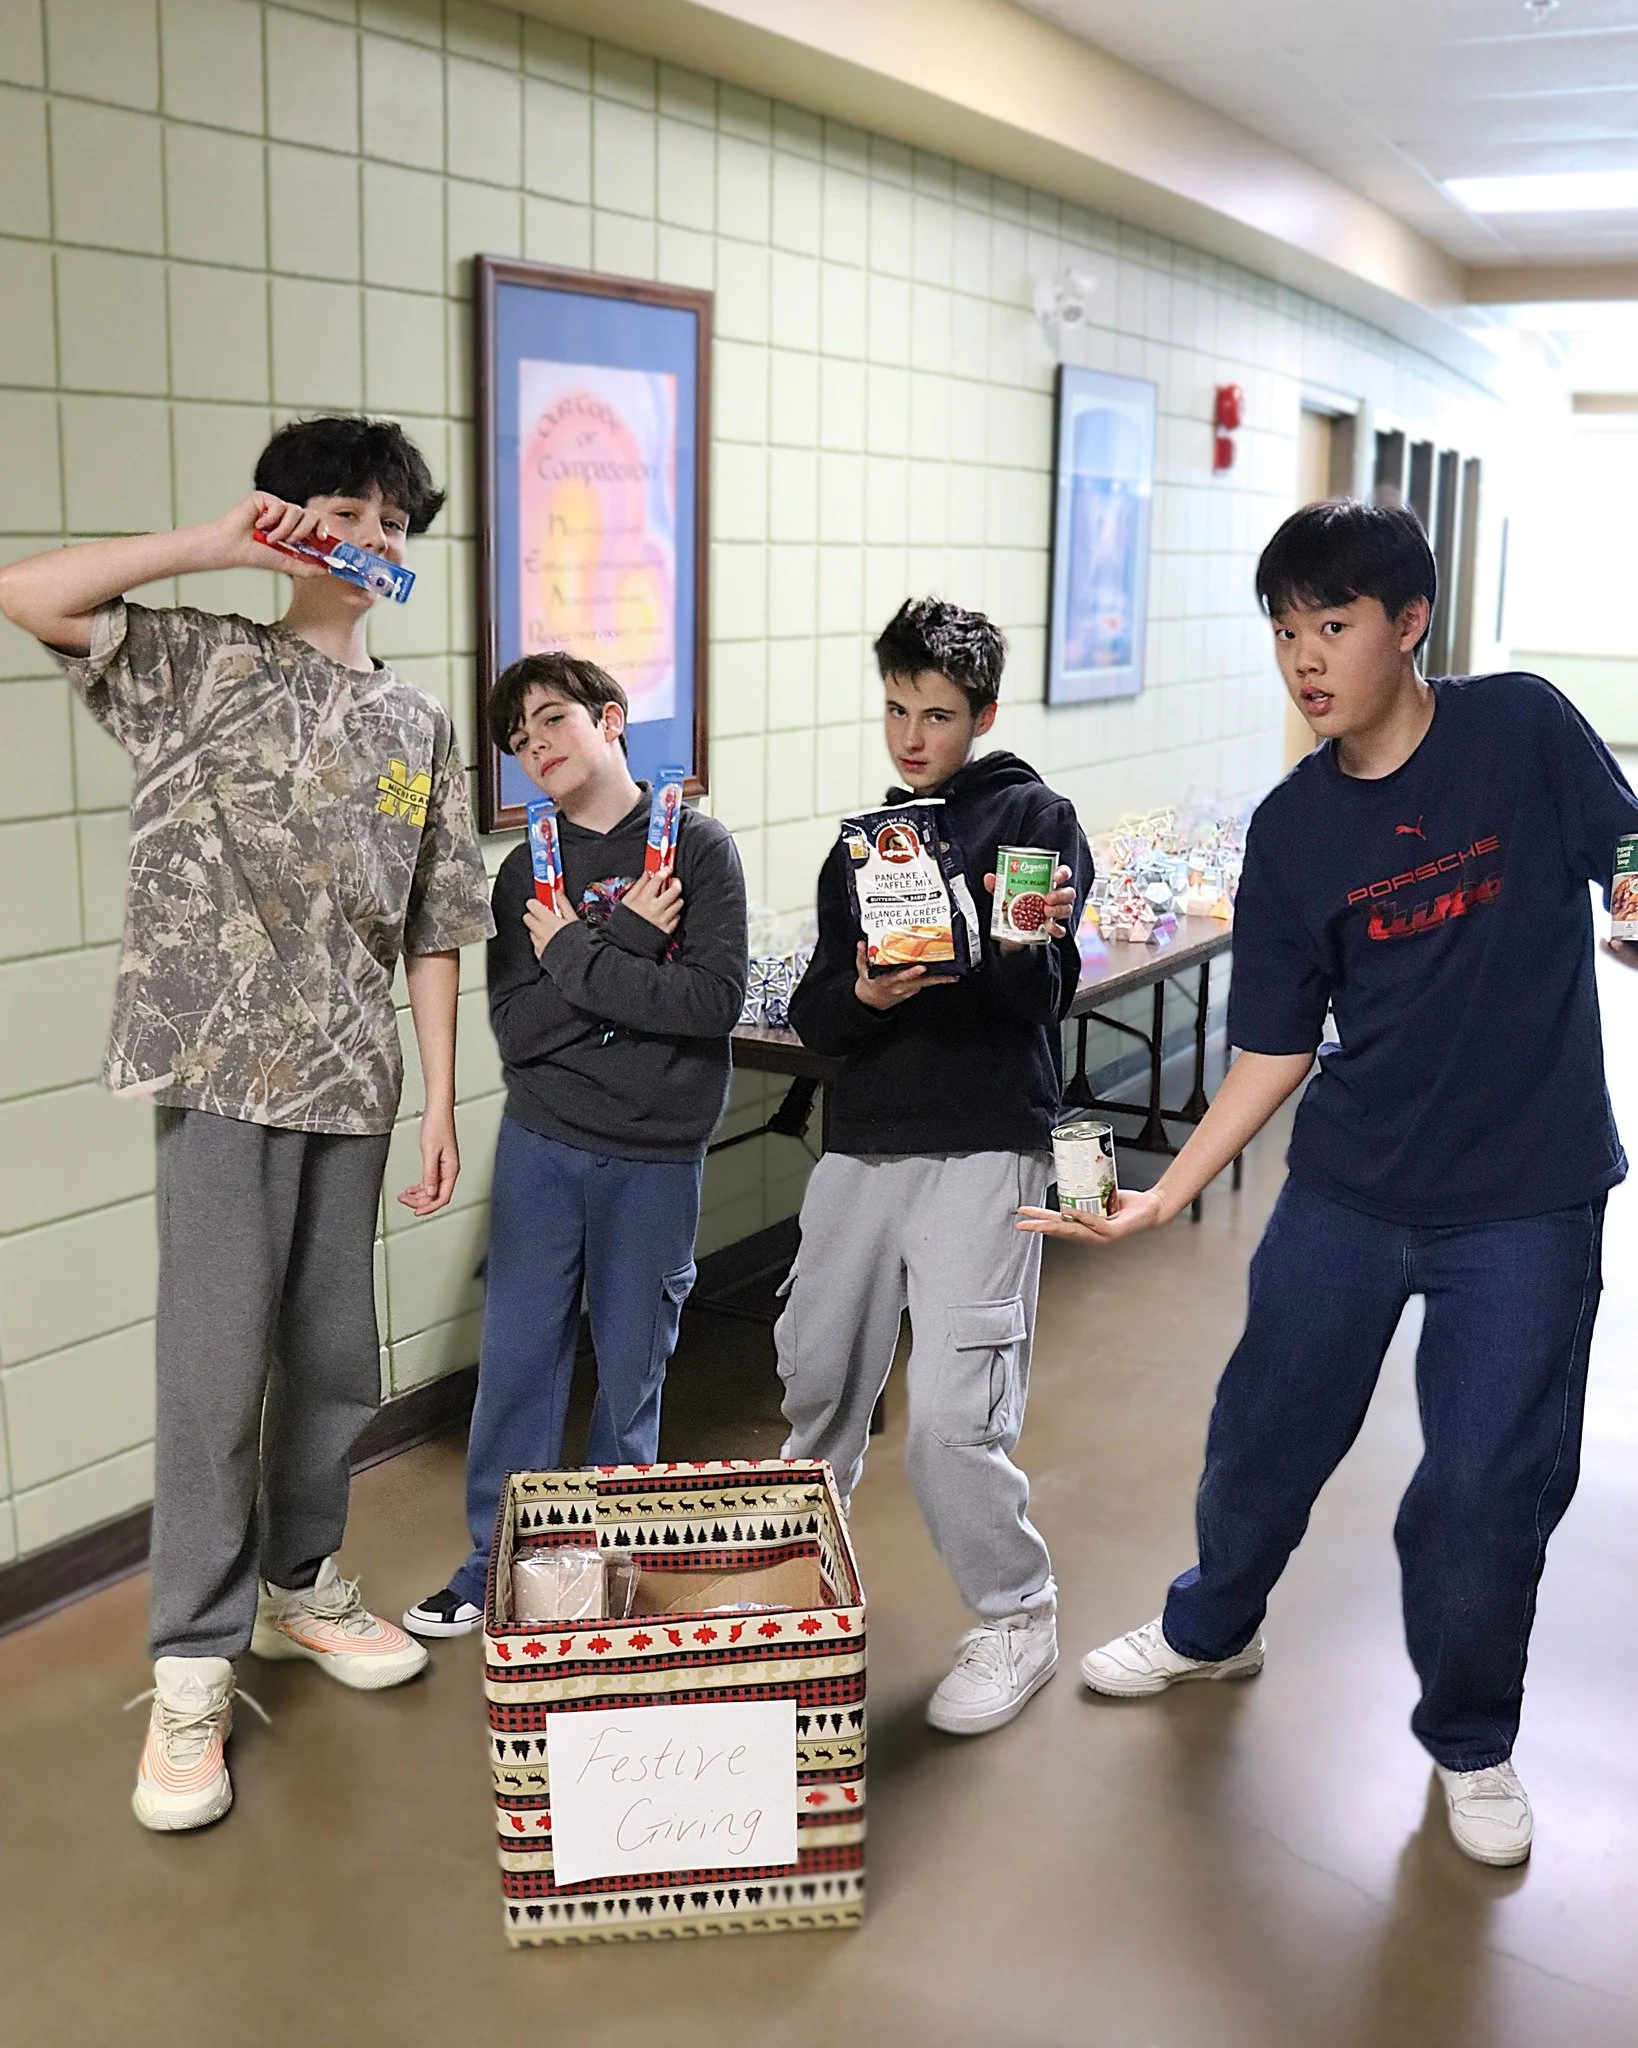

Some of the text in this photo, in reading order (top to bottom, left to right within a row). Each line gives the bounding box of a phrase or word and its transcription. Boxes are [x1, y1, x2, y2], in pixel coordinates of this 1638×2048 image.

[388, 783, 425, 804] MICHIGA
[1347, 835, 1500, 905] PORSCHE
[875, 871, 918, 882] PANCAKE
[915, 878, 933, 887] MIX
[1011, 878, 1027, 886] BLACK
[913, 906, 947, 916] CRÊPES
[875, 919, 884, 928] ET
[896, 916, 938, 925] GAUFRES
[577, 1727, 746, 1784] Festive
[617, 1797, 763, 1855] Giving
